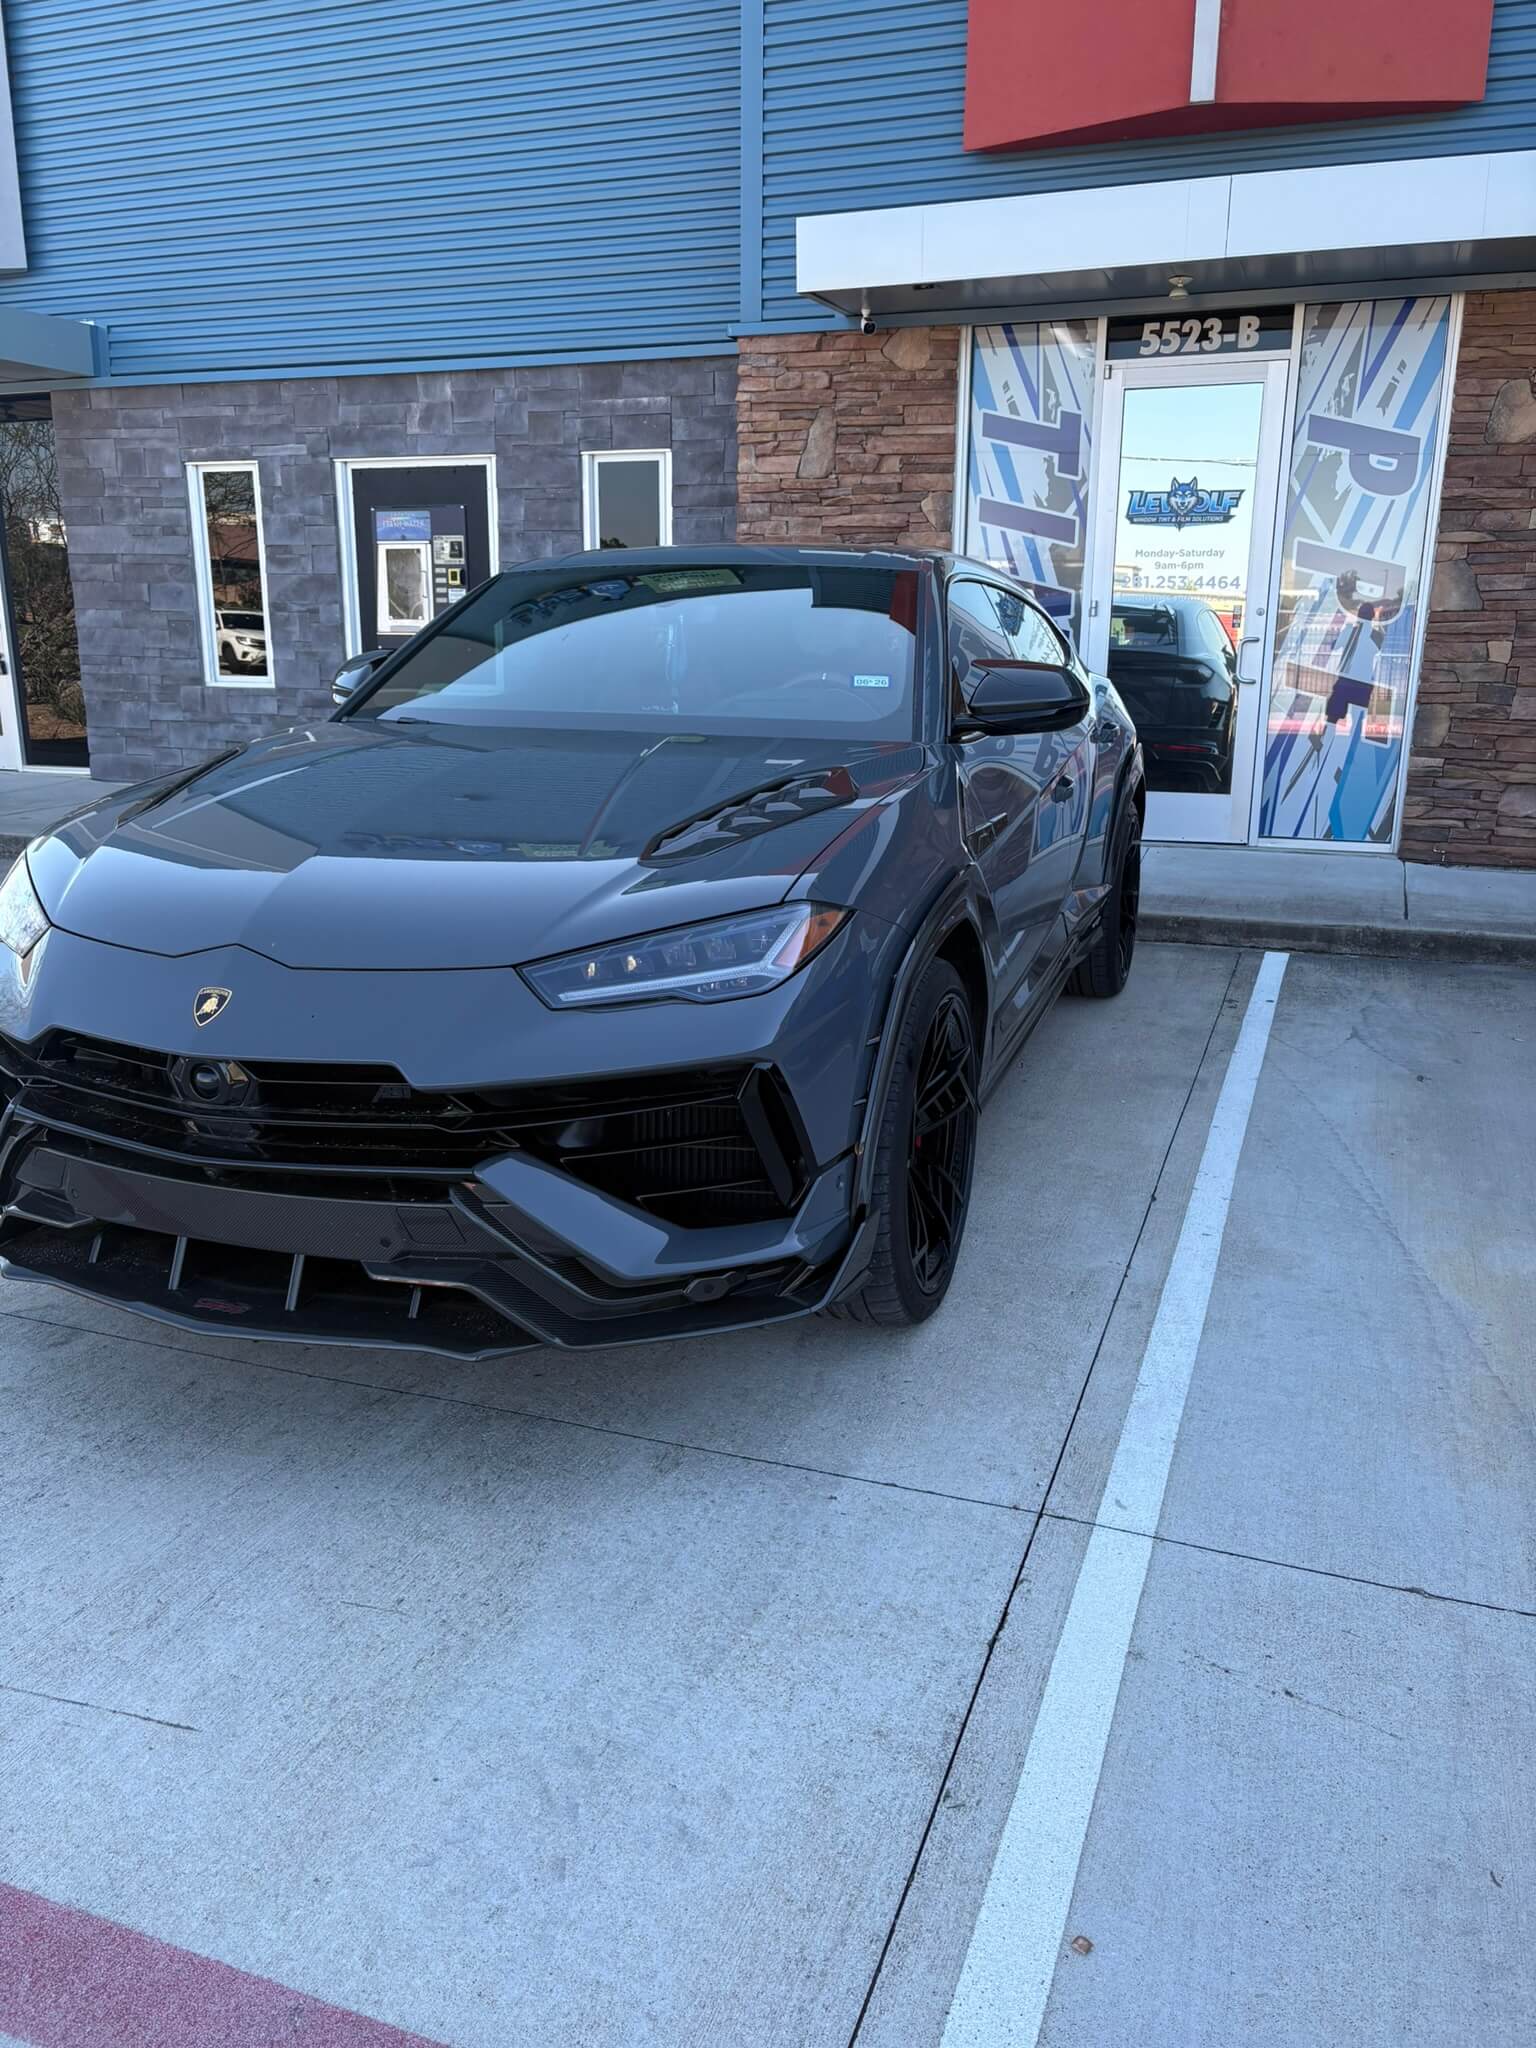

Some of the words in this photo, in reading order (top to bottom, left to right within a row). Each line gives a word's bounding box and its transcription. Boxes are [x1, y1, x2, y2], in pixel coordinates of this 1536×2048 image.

[1139, 315, 1261, 356] 5523-B
[1134, 548, 1225, 559] Monday-Saturday
[1154, 561, 1205, 571] 9am-6pm
